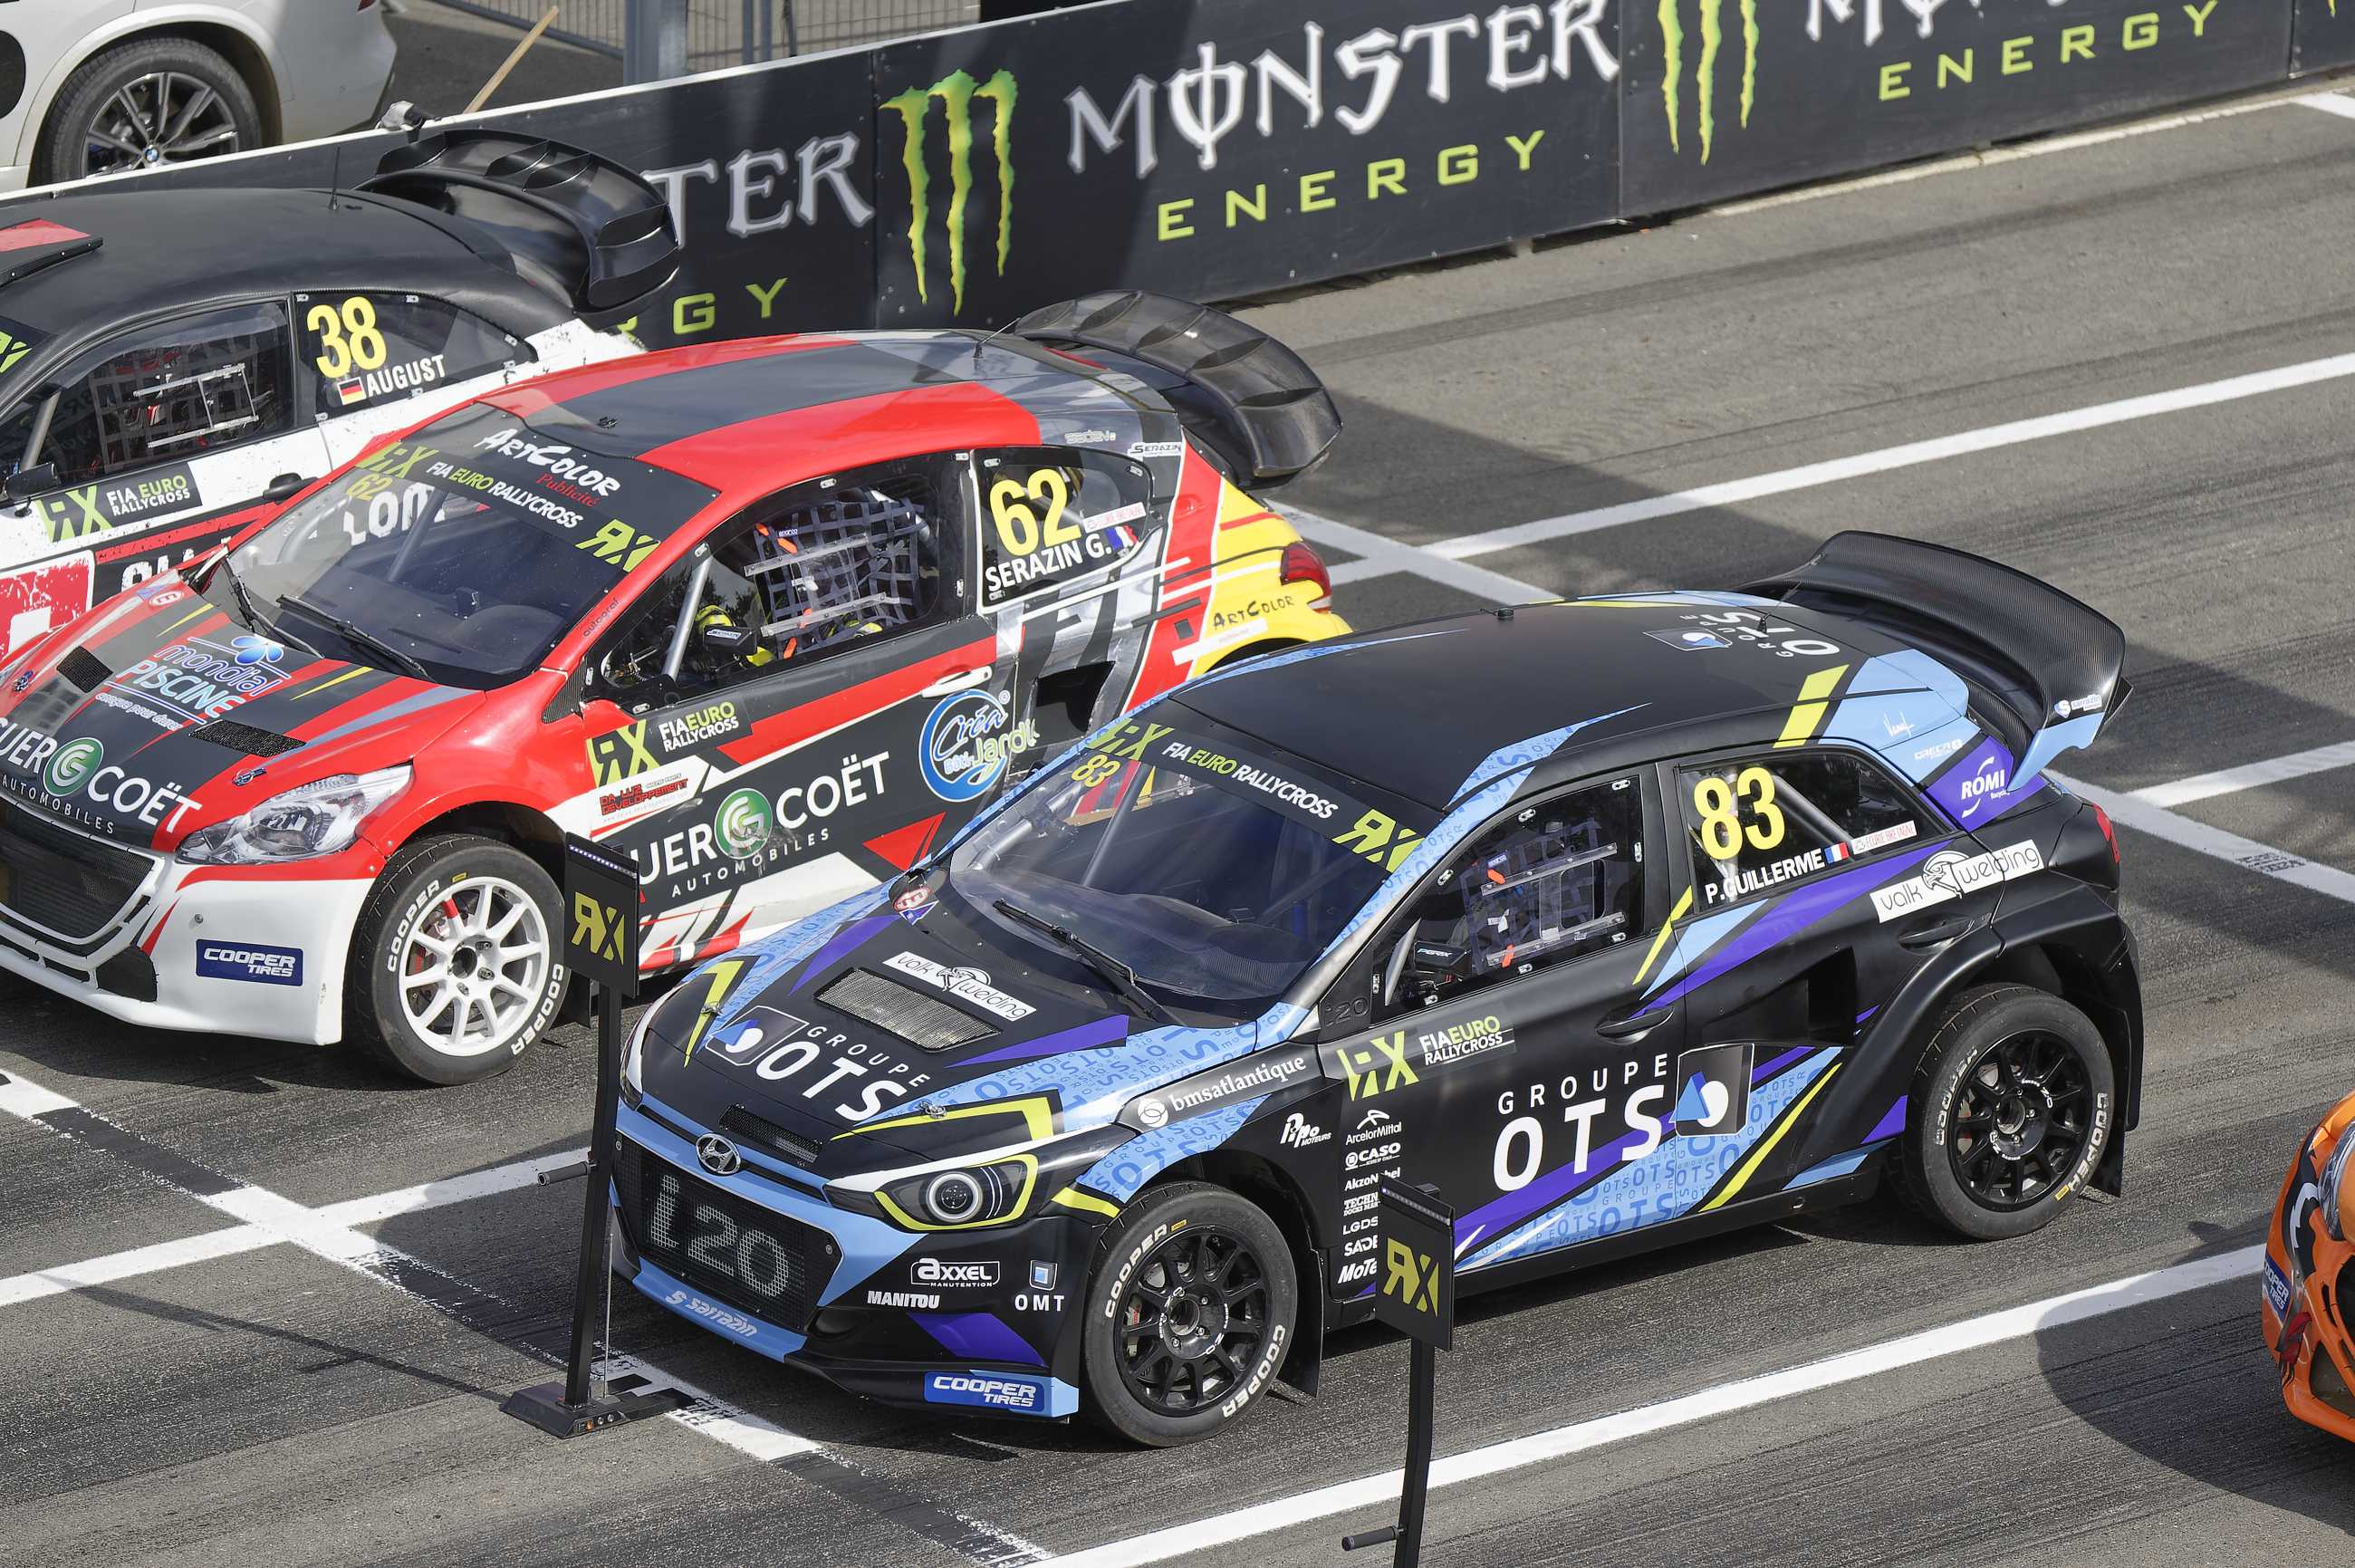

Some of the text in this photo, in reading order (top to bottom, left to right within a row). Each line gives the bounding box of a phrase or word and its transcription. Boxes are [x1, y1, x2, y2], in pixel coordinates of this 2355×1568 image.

[1879, 0, 2216, 101] ENERGY
[1064, 0, 1621, 178] MONSTER
[641, 130, 875, 249] TER
[1157, 130, 1545, 242] ENERGY
[307, 296, 387, 380] 38
[361, 354, 447, 400] AUGUST
[106, 476, 187, 508] FIA EURO
[111, 487, 190, 516] RALLYCROSS
[346, 474, 393, 501] 62
[426, 461, 584, 529] FIA EURO RALLYCROSS
[536, 473, 601, 508] Publicité
[989, 467, 1081, 557] 62
[985, 533, 1112, 592] SERAZIN G.
[1680, 615, 1794, 658] GROUPE
[116, 659, 246, 718] PISCINE
[154, 644, 284, 697] mondial
[658, 702, 735, 740] FIA EURO
[663, 717, 739, 752] RALLYCROSS
[775, 751, 890, 829] COËT
[1071, 754, 1121, 788] 83
[1162, 742, 1340, 820] FIA EURO RALLYCROSS
[1961, 769, 2005, 800] ROMI
[2, 774, 114, 834] AUTOMOBILES
[87, 765, 202, 833] COËT
[1694, 767, 1785, 860] 83
[671, 827, 831, 899] AUTOMOBILES
[1880, 847, 2038, 910] valk welding
[388, 880, 440, 973] COOPER
[204, 948, 296, 967] COOPER
[247, 963, 293, 977] TIRES
[512, 964, 563, 1056] COOPER
[896, 954, 1029, 1019] valk welding
[807, 1025, 930, 1089] GROUPE
[1418, 1015, 1501, 1053] FIA EURO
[1425, 1031, 1504, 1065] RALLYCROSS
[755, 1041, 908, 1121] OTS
[1168, 1057, 1306, 1111] bmsatlantique
[1497, 1053, 1668, 1115] GROUPE
[1280, 1112, 1320, 1149] Pipo
[1301, 1132, 1331, 1147] MOTEURS
[1345, 1121, 1402, 1145] ArcelorMittal
[1359, 1142, 1401, 1162] CASO
[1493, 1085, 1666, 1192] OTS
[1344, 1167, 1401, 1191] AkzoNbel
[651, 1175, 789, 1297] i20
[1105, 1224, 1167, 1318] COOPER
[2264, 1262, 2289, 1302] OOPER
[2270, 1285, 2285, 1309] TIRES
[685, 1297, 757, 1336] sarrazin
[867, 1290, 940, 1309] MANITOU
[933, 1376, 1036, 1398] COOPER
[1223, 1324, 1284, 1419] COOPER
[984, 1393, 1033, 1407] TIRES
